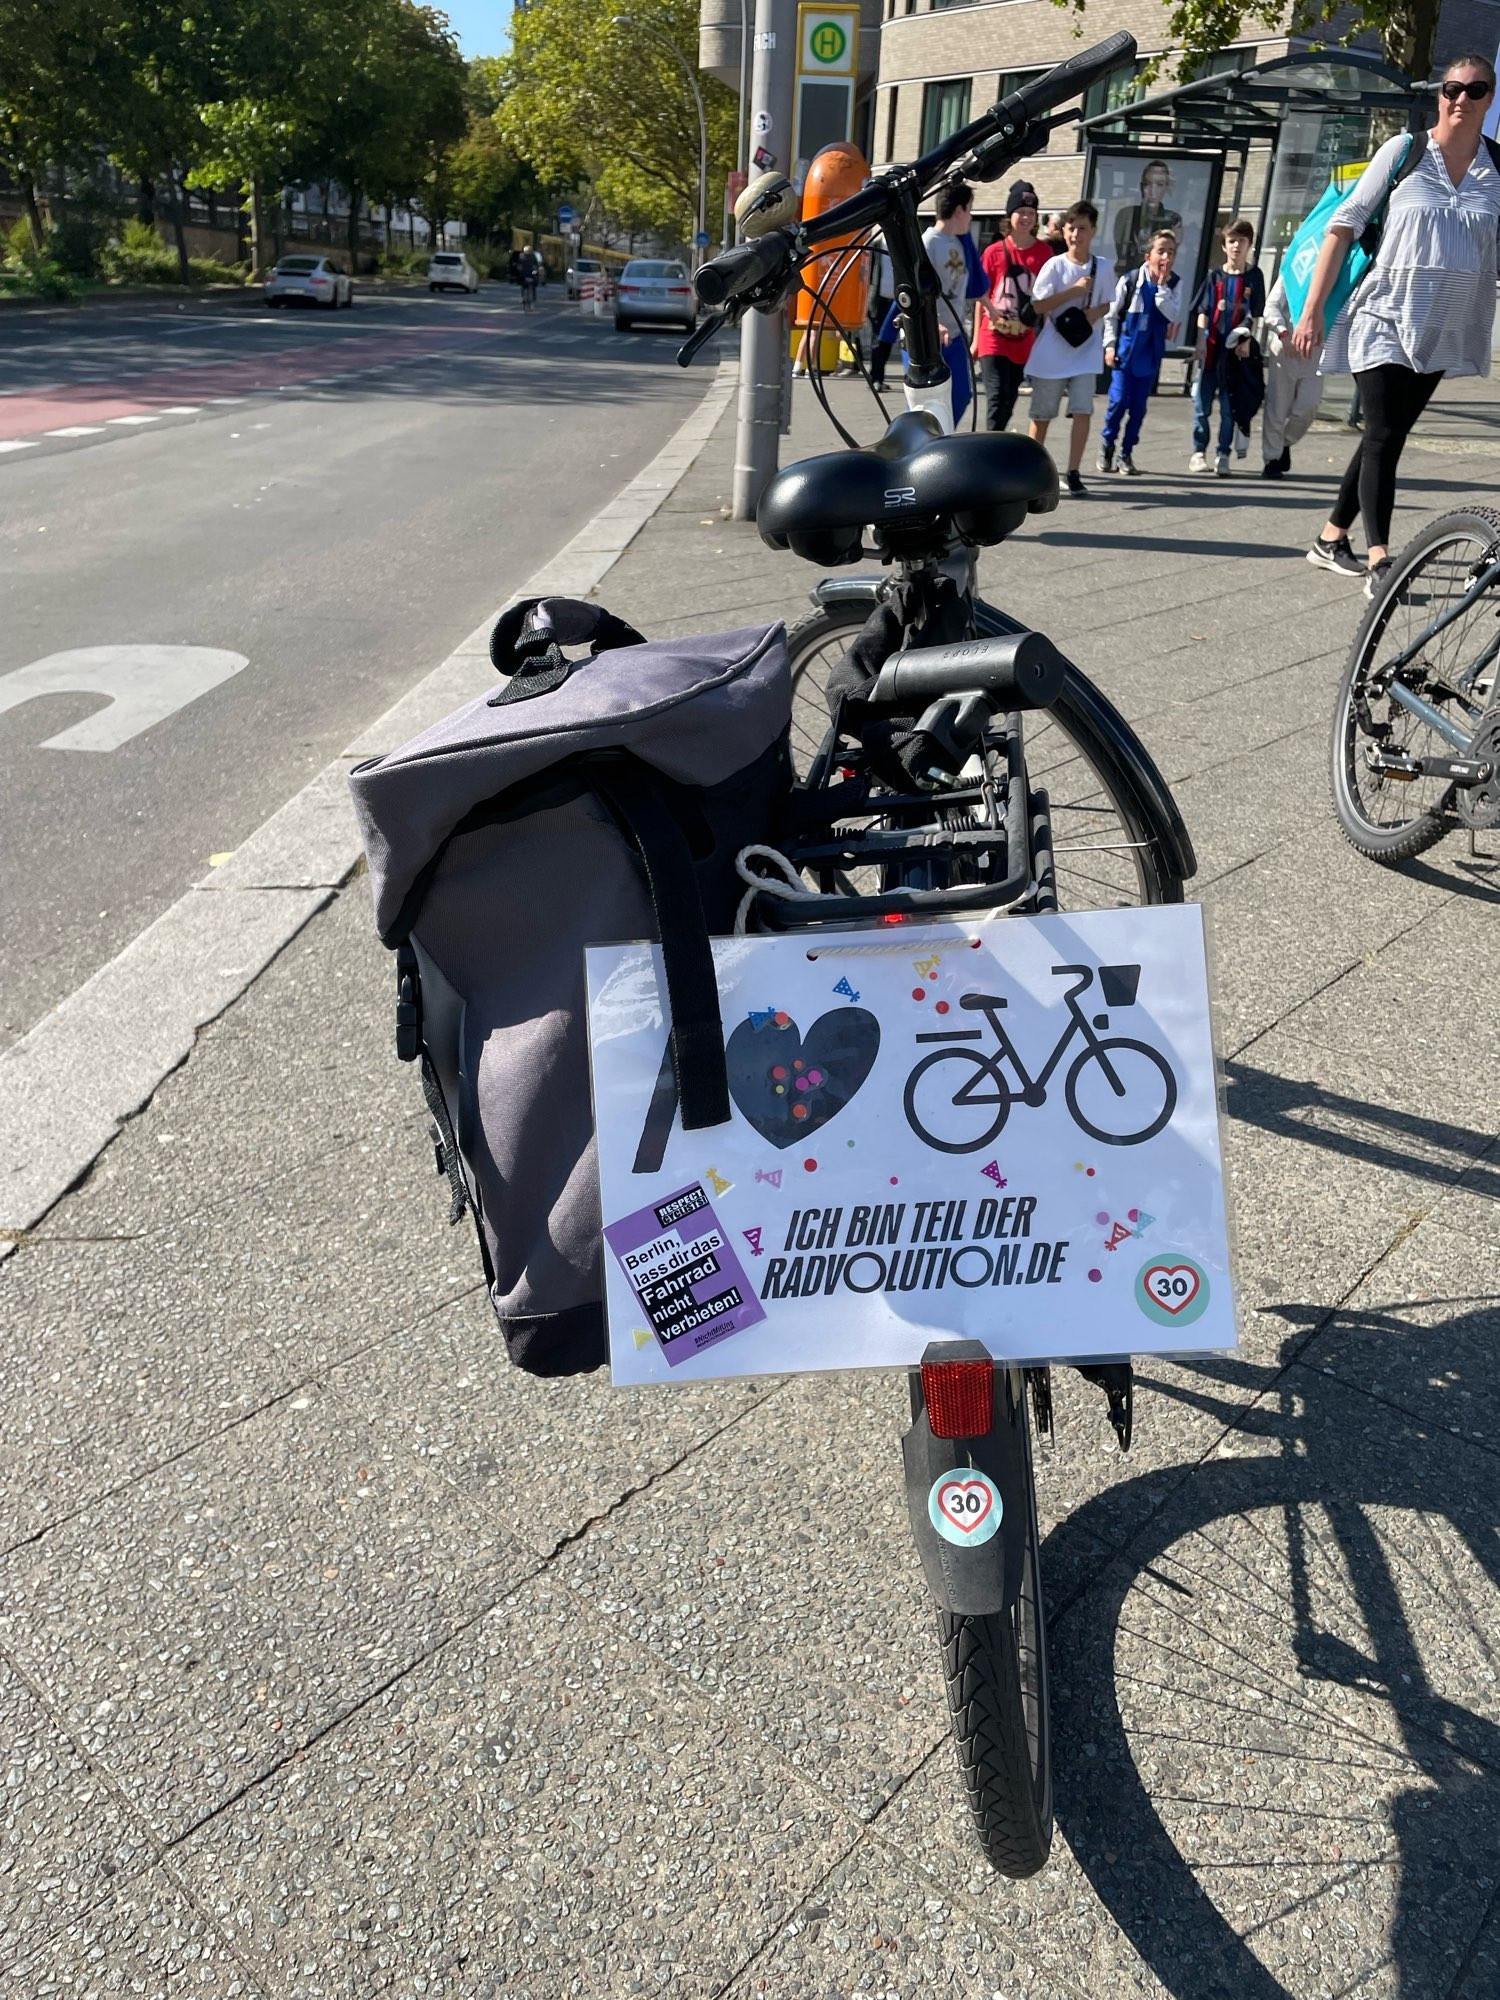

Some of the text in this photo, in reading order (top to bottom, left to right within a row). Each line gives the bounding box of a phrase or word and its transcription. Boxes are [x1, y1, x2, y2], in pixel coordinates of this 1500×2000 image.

[820, 31, 836, 55] H
[884, 486, 916, 504] SR
[658, 1188, 703, 1217] RESPECT
[661, 1195, 708, 1225] CYCLISTS!
[784, 1196, 1038, 1251] ICH BIN TEIL DER
[625, 1236, 681, 1270] Berlin,
[633, 1235, 721, 1287] lass dir das
[641, 1256, 717, 1306] Fahrrad
[760, 1241, 1070, 1300] RADVOLUTION.DE
[1157, 1277, 1188, 1297] 30
[652, 1293, 693, 1323] nicht
[660, 1289, 741, 1340] verbieten!
[950, 1493, 981, 1514] 30
